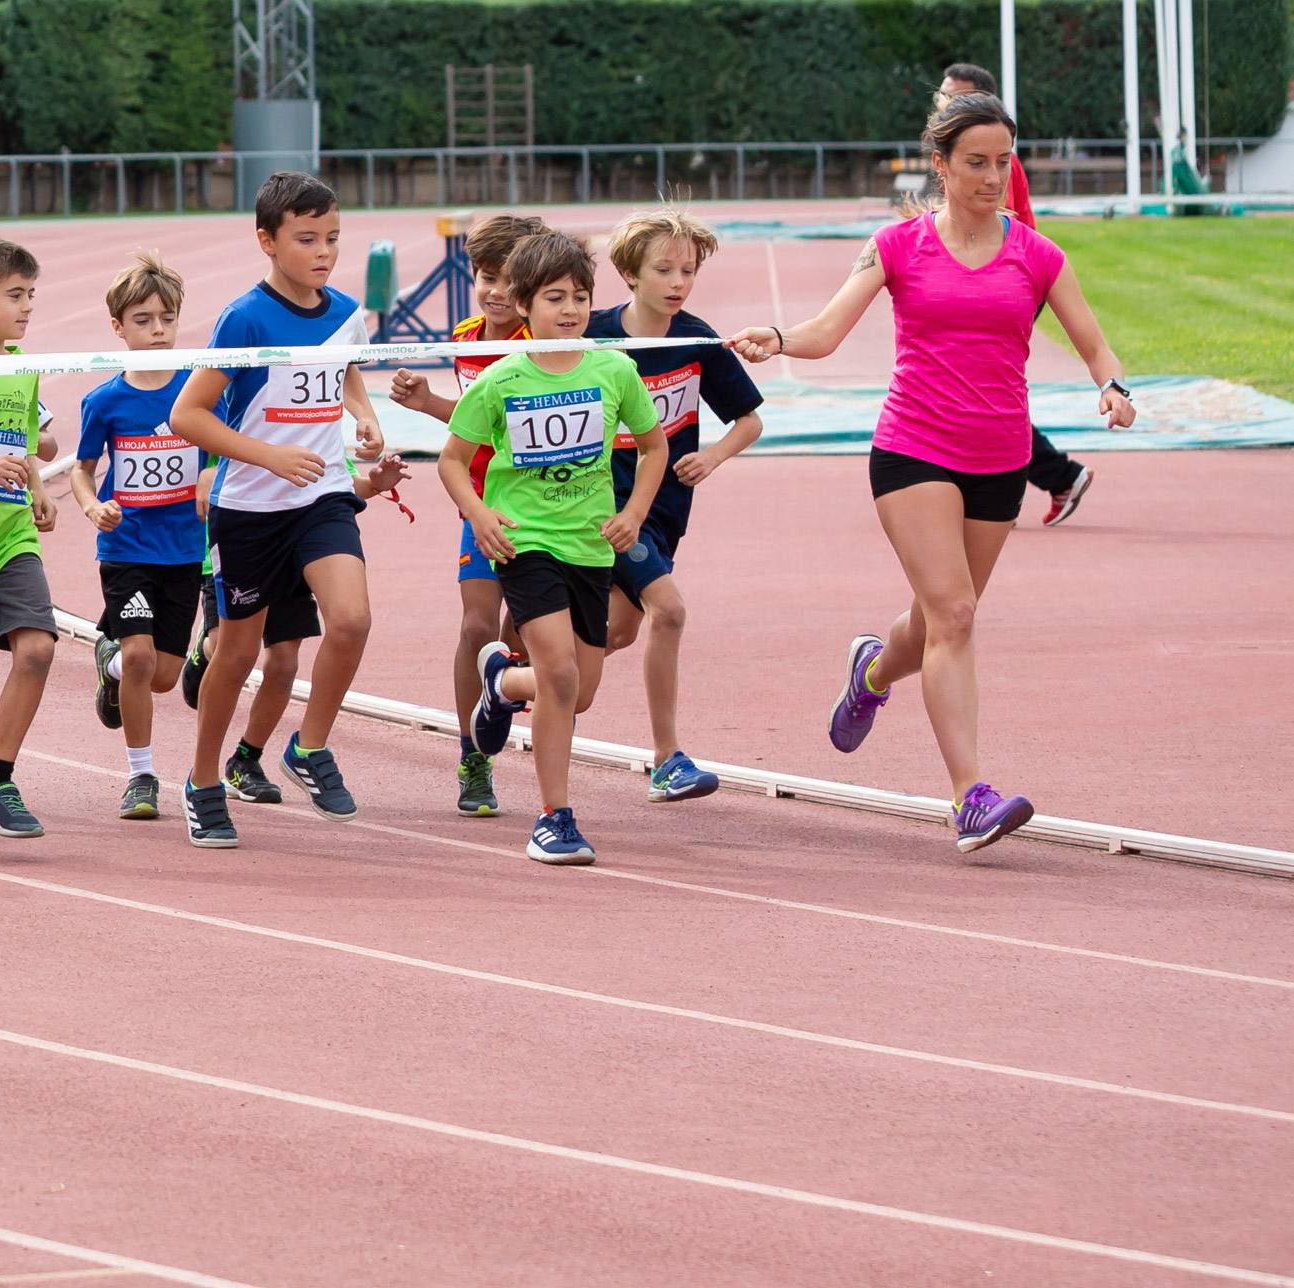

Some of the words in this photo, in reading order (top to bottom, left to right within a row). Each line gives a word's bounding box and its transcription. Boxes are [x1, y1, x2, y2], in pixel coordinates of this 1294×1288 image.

[534, 390, 595, 408] HEMAFIX
[522, 410, 590, 449] 107
[117, 441, 124, 449] LA
[124, 441, 147, 449] RIOJA
[123, 456, 184, 488] 288
[120, 607, 154, 619] adidas
